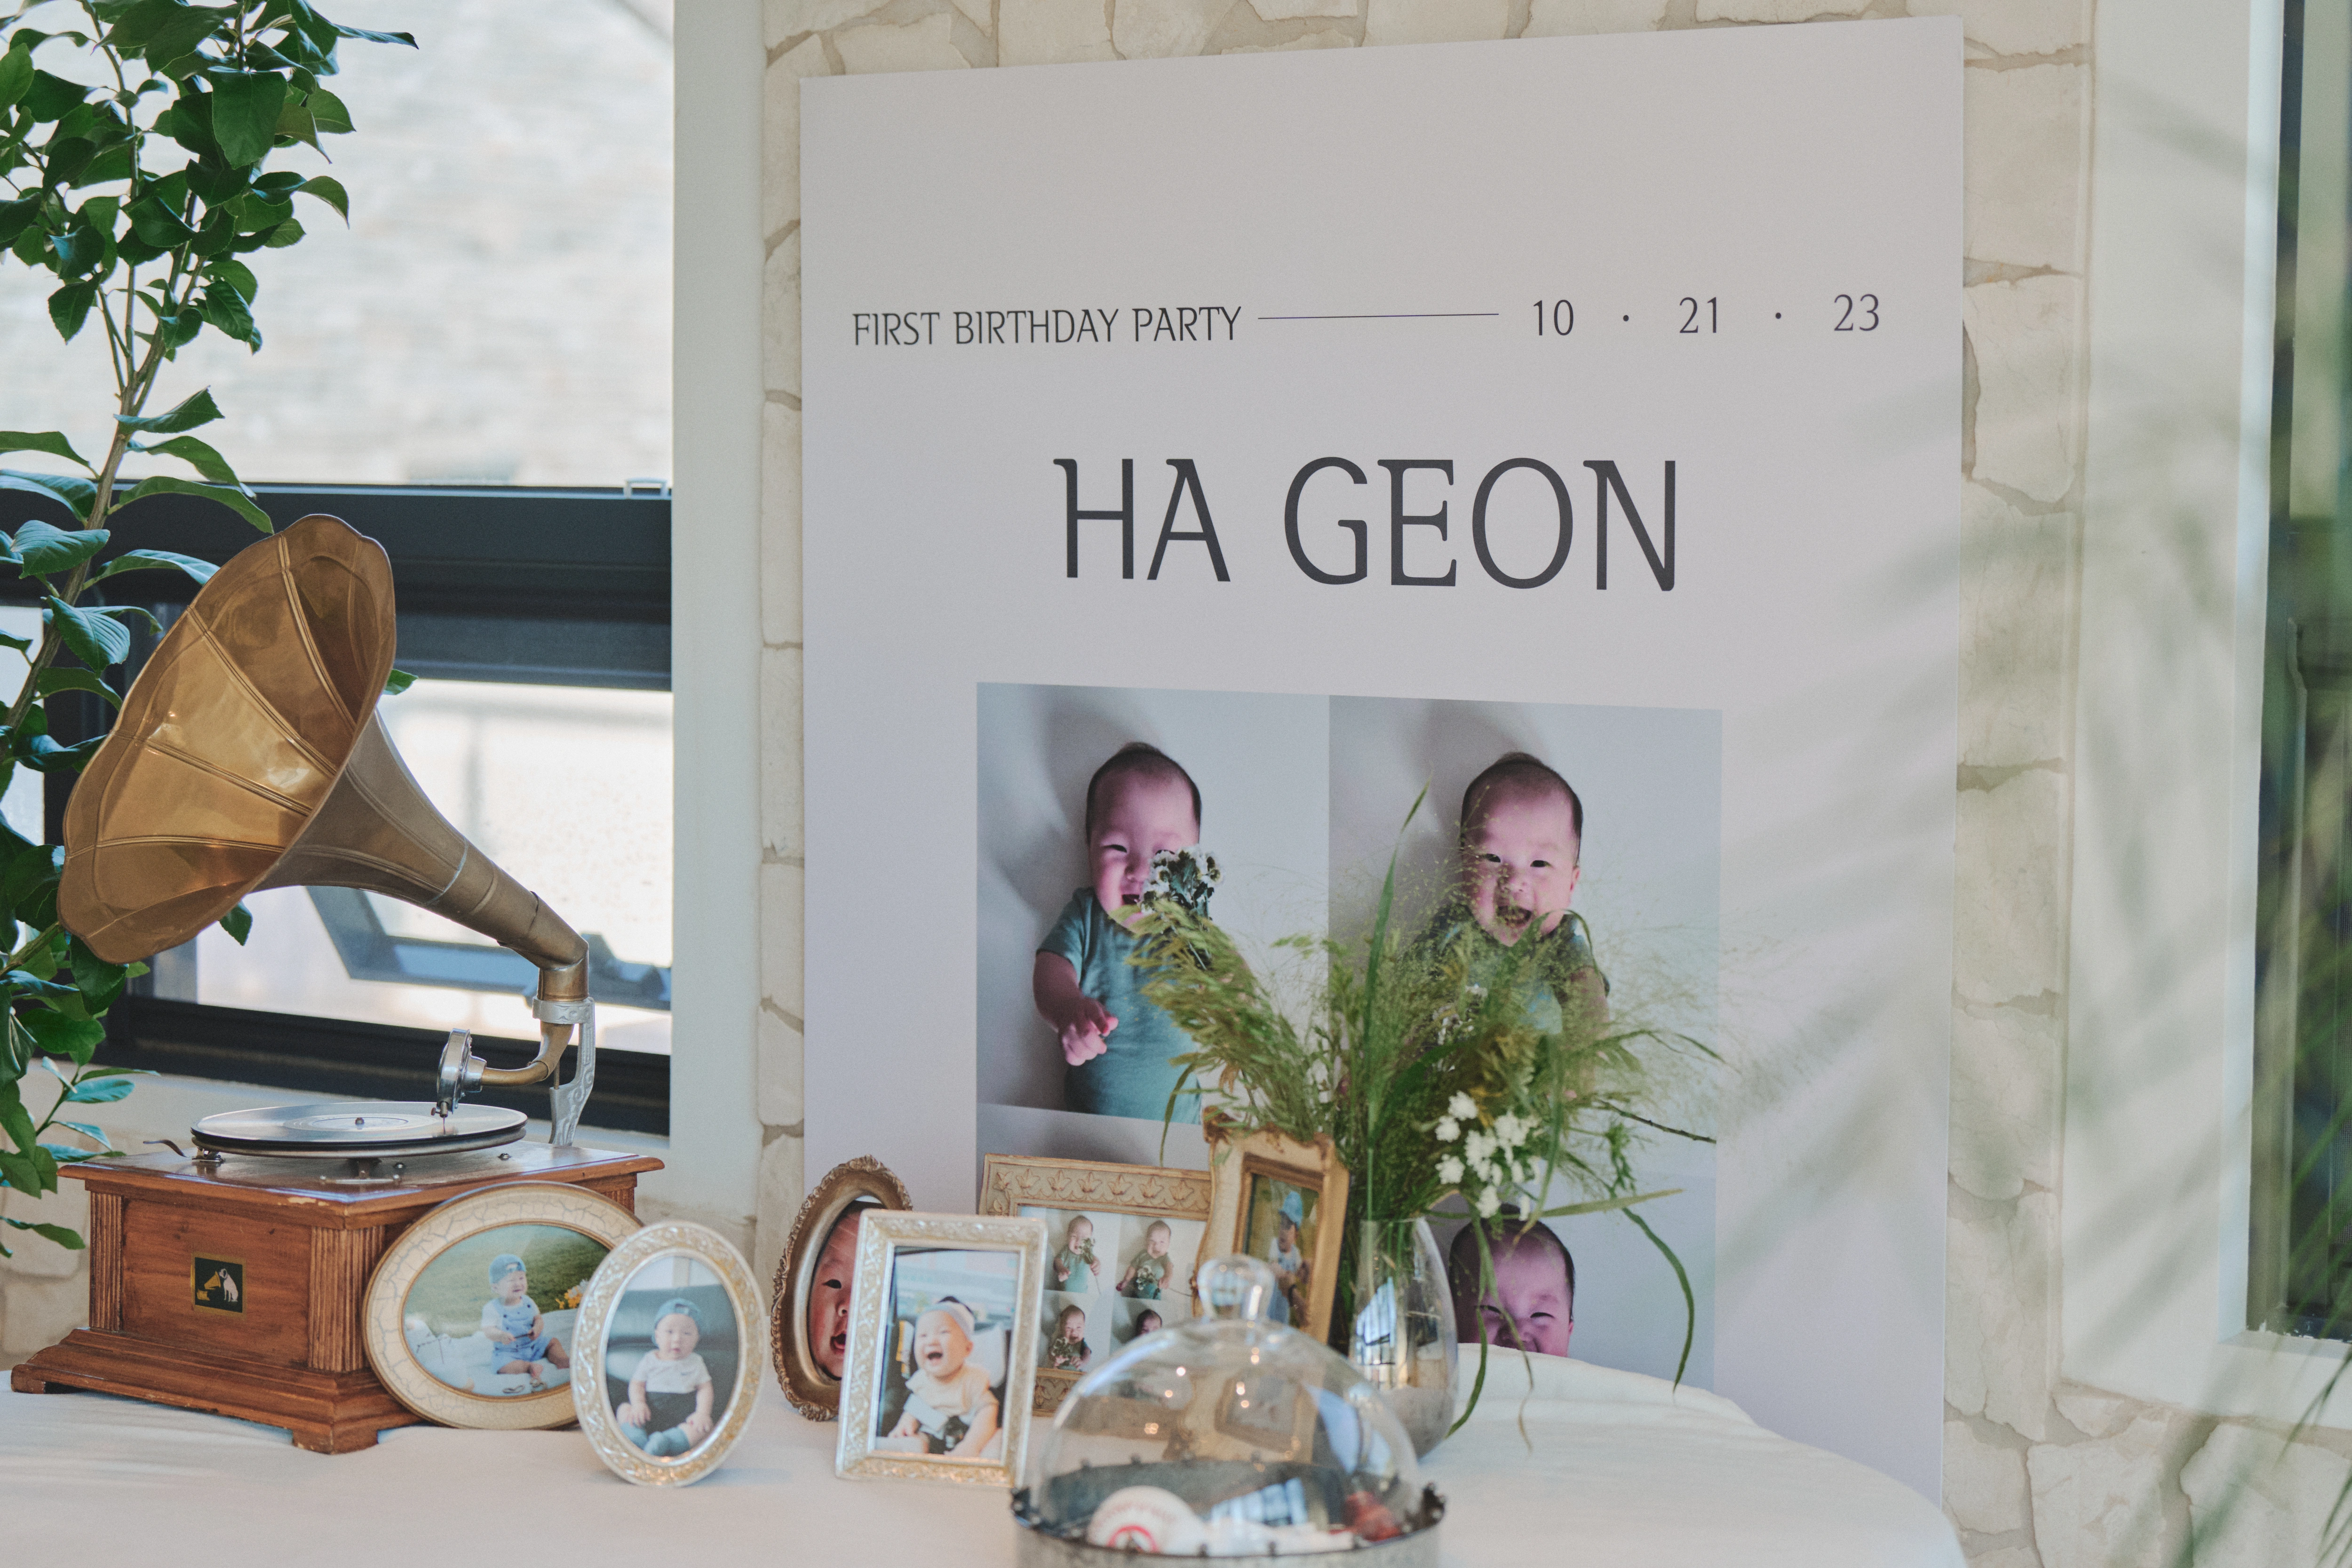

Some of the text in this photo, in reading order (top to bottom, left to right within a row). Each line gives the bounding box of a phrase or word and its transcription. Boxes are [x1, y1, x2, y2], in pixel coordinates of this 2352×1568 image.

[852, 306, 1242, 346] FIRST BIRTHDAY PARTY
[1533, 293, 1880, 336] 10 21 23
[1052, 456, 1676, 592] HA GEON
